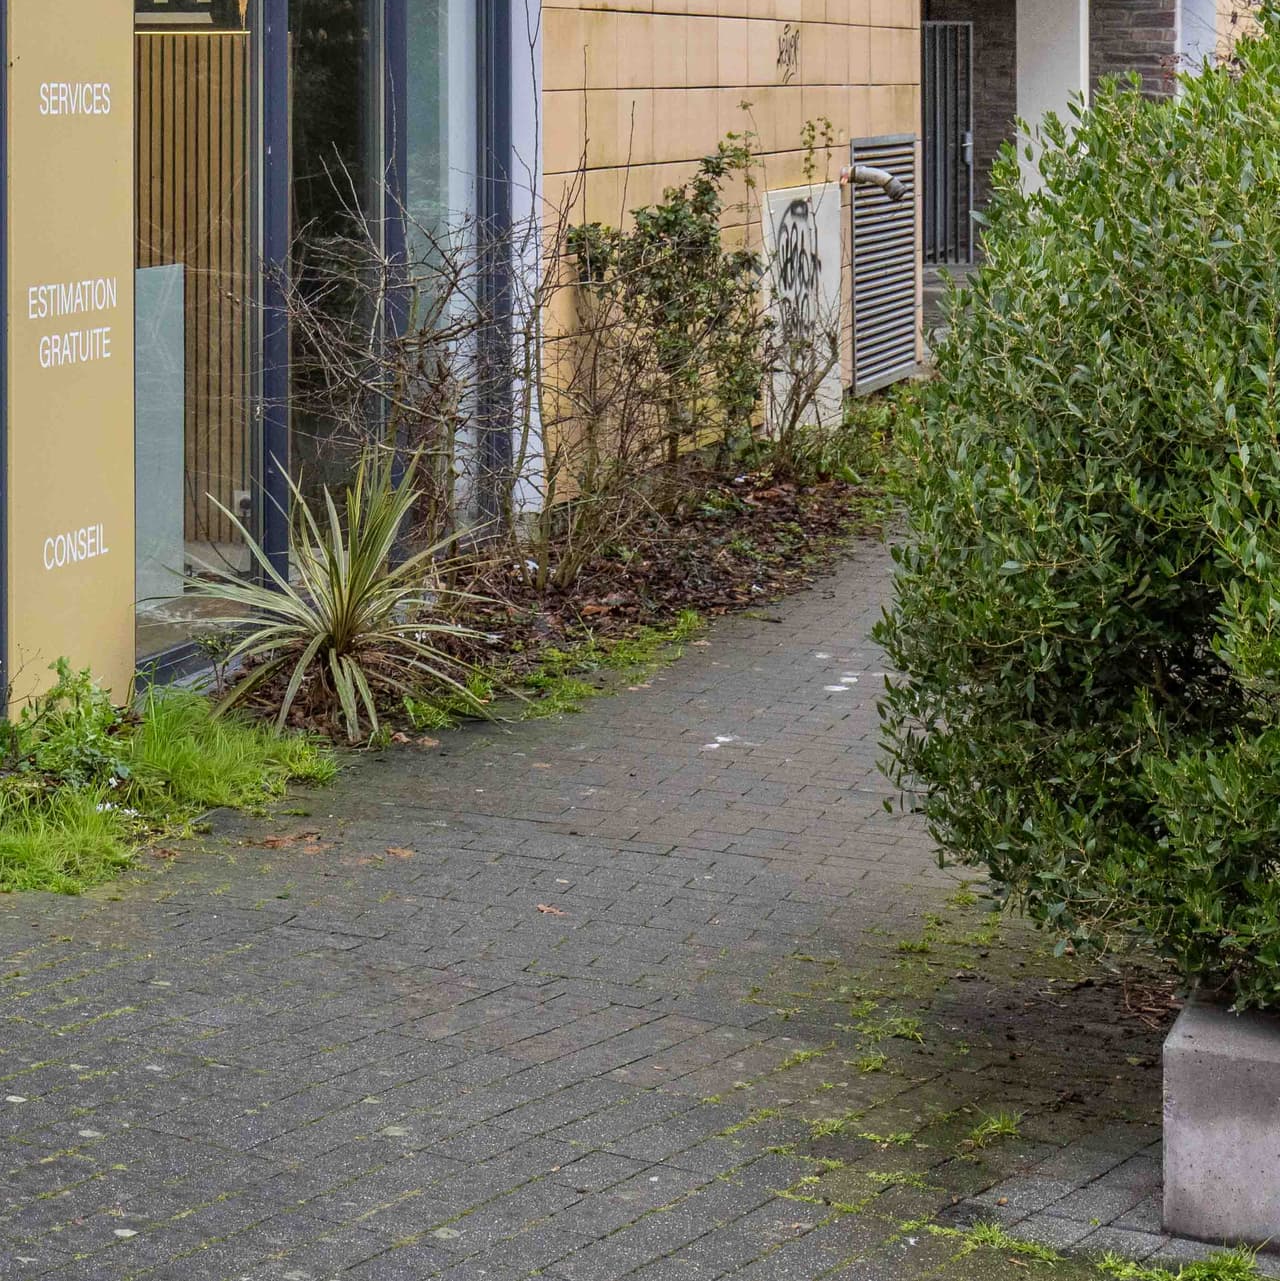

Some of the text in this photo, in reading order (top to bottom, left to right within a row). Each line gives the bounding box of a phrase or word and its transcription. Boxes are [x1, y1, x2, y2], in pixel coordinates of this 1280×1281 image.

[39, 82, 111, 116] SERVICES
[28, 277, 117, 320] ESTIMATION
[39, 327, 112, 369] GRATUITE
[43, 523, 109, 571] CONSEIL
